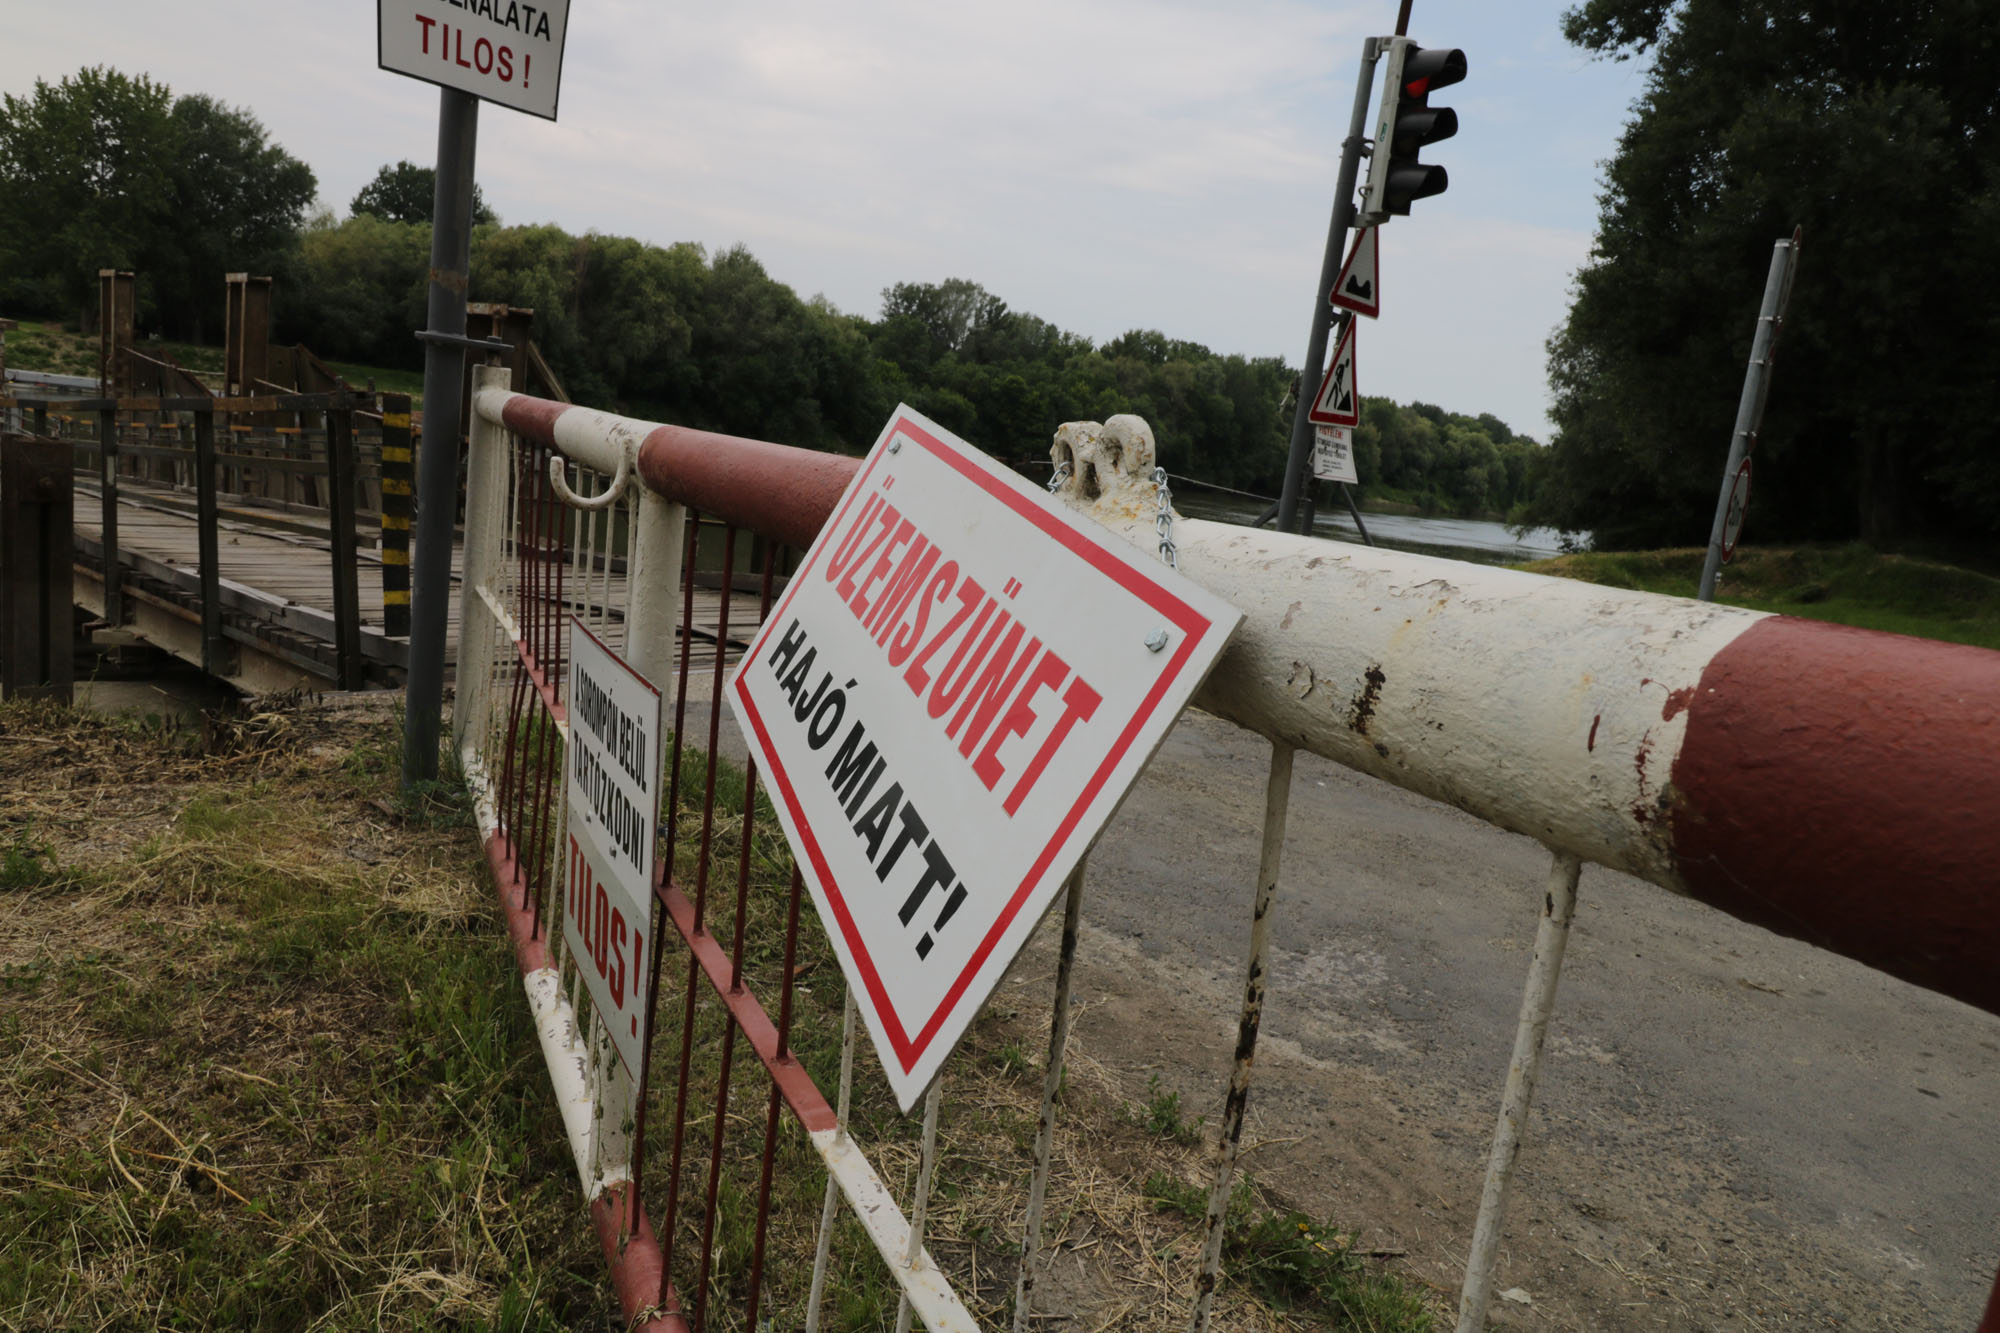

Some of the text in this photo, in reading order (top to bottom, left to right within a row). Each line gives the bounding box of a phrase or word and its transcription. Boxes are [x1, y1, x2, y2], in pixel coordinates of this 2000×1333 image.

[415, 13, 531, 89] TILOS!
[574, 662, 647, 795] A SOROMPÓN BELÜL
[825, 474, 1104, 819] ÜZEMSZÜNET
[573, 728, 646, 877] TARTÓZKODNI
[768, 618, 969, 962] HAJÓ MIATT!
[568, 831, 644, 1041] TILOS!
